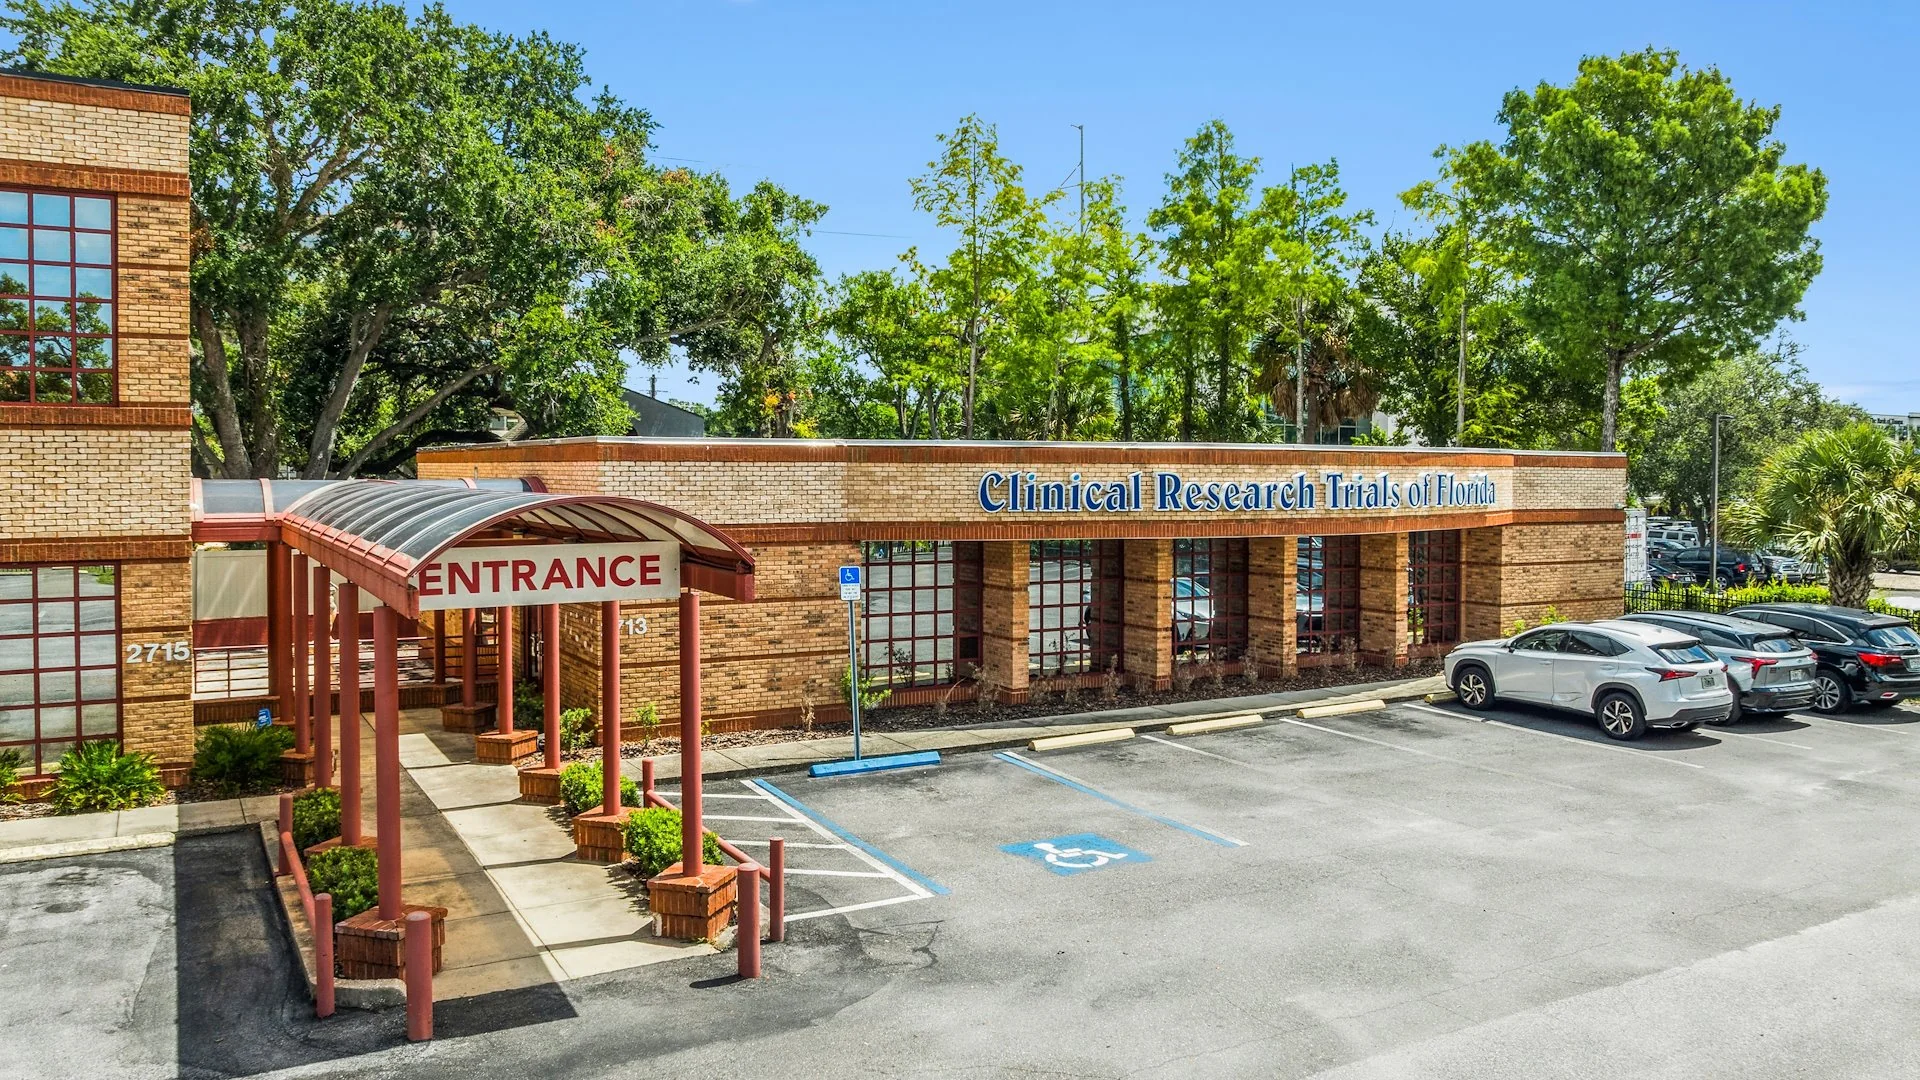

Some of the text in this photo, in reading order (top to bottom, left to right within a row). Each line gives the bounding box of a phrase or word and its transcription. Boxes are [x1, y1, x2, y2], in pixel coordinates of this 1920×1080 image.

[979, 470, 1496, 512] Clinical Research Trials of Florida
[418, 554, 662, 596] ENTRANCE
[126, 641, 191, 664] 2715
